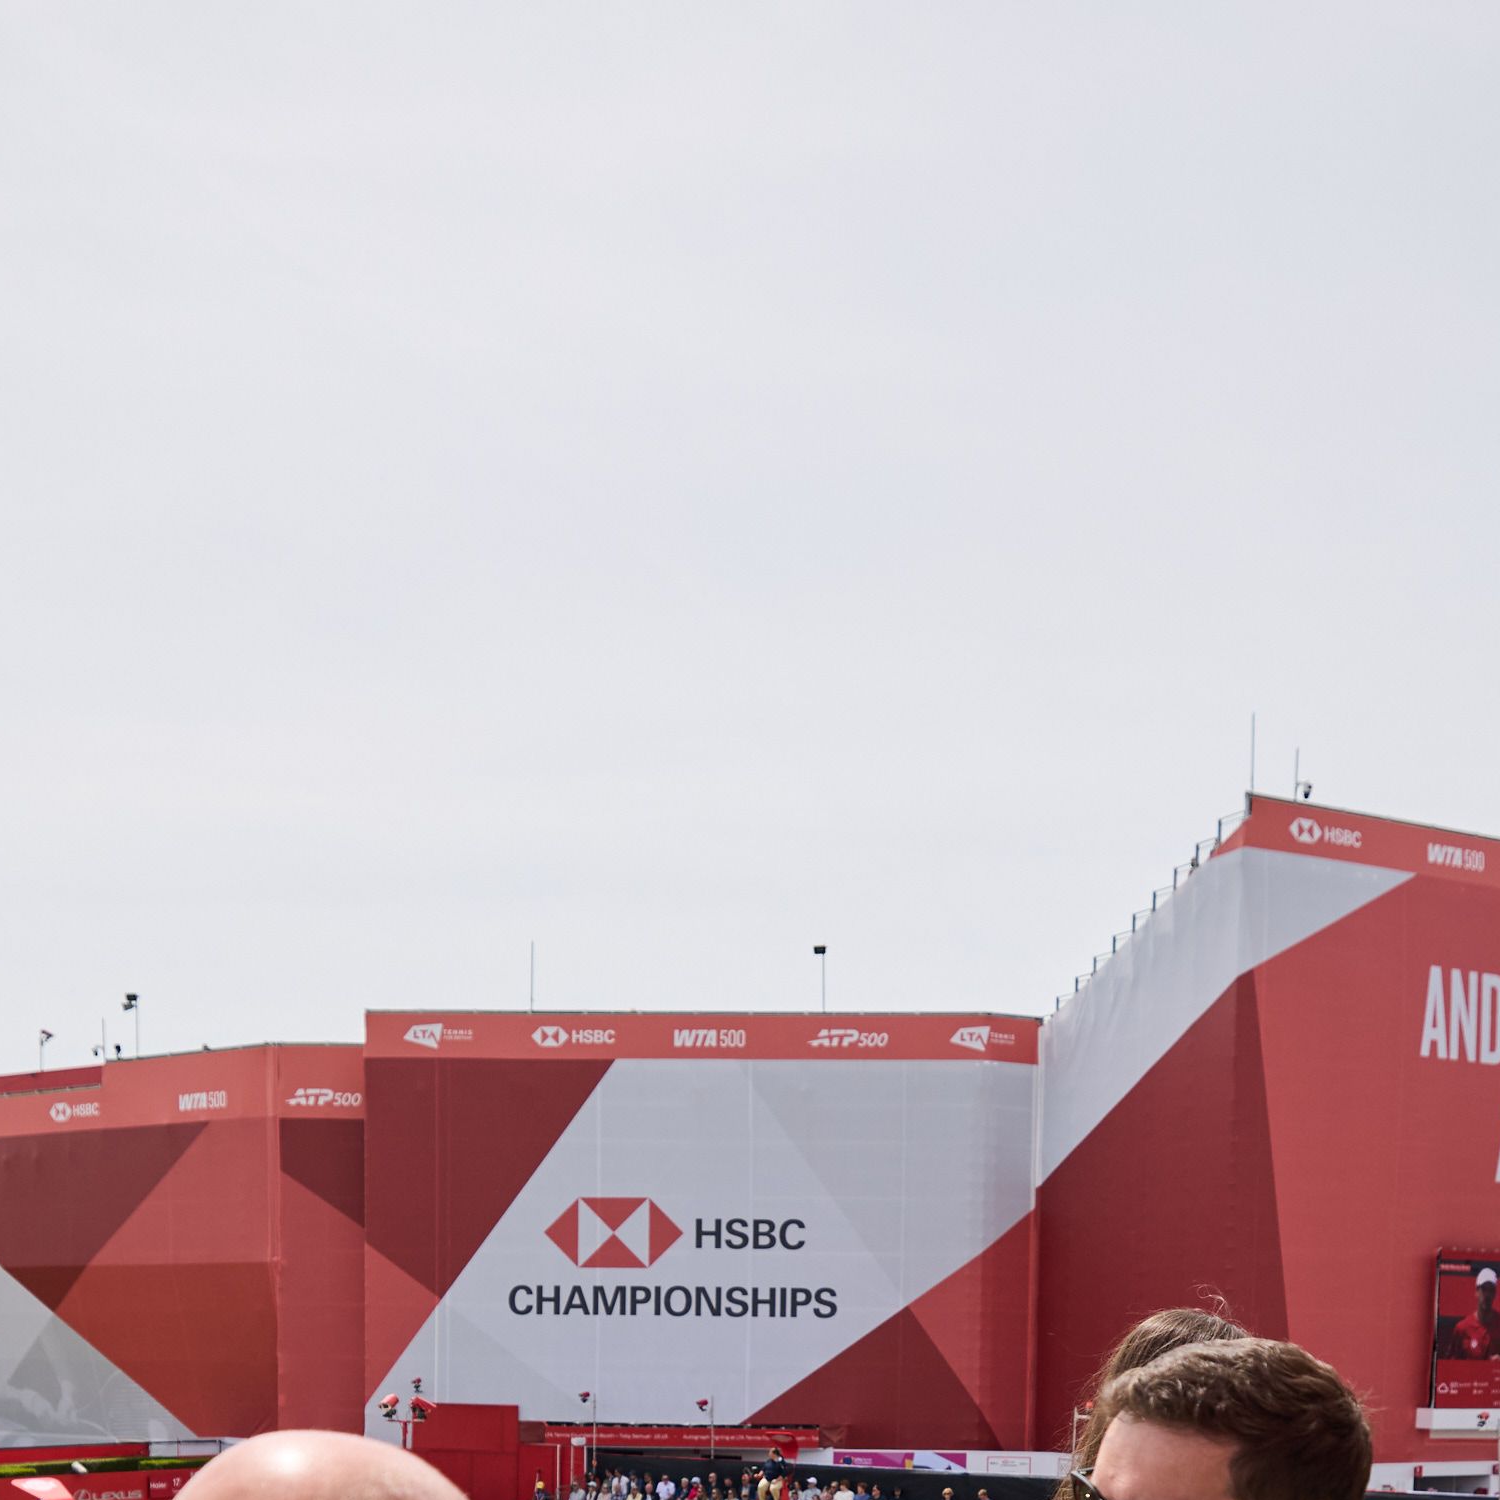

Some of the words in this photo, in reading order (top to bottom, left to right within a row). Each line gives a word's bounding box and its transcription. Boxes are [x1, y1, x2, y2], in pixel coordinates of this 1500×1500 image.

[1323, 827, 1362, 849] HSBC
[571, 1029, 615, 1044] HSBC
[673, 1029, 717, 1047] WTA
[719, 1029, 746, 1047] 500
[807, 1029, 859, 1048] ATP
[858, 1032, 889, 1047] 500
[285, 1088, 333, 1106] ATP
[333, 1092, 363, 1107] 500
[72, 1102, 100, 1118] HSBC
[694, 1218, 806, 1250] HSBC
[508, 1284, 838, 1319] CHAMPIONSHIPS
